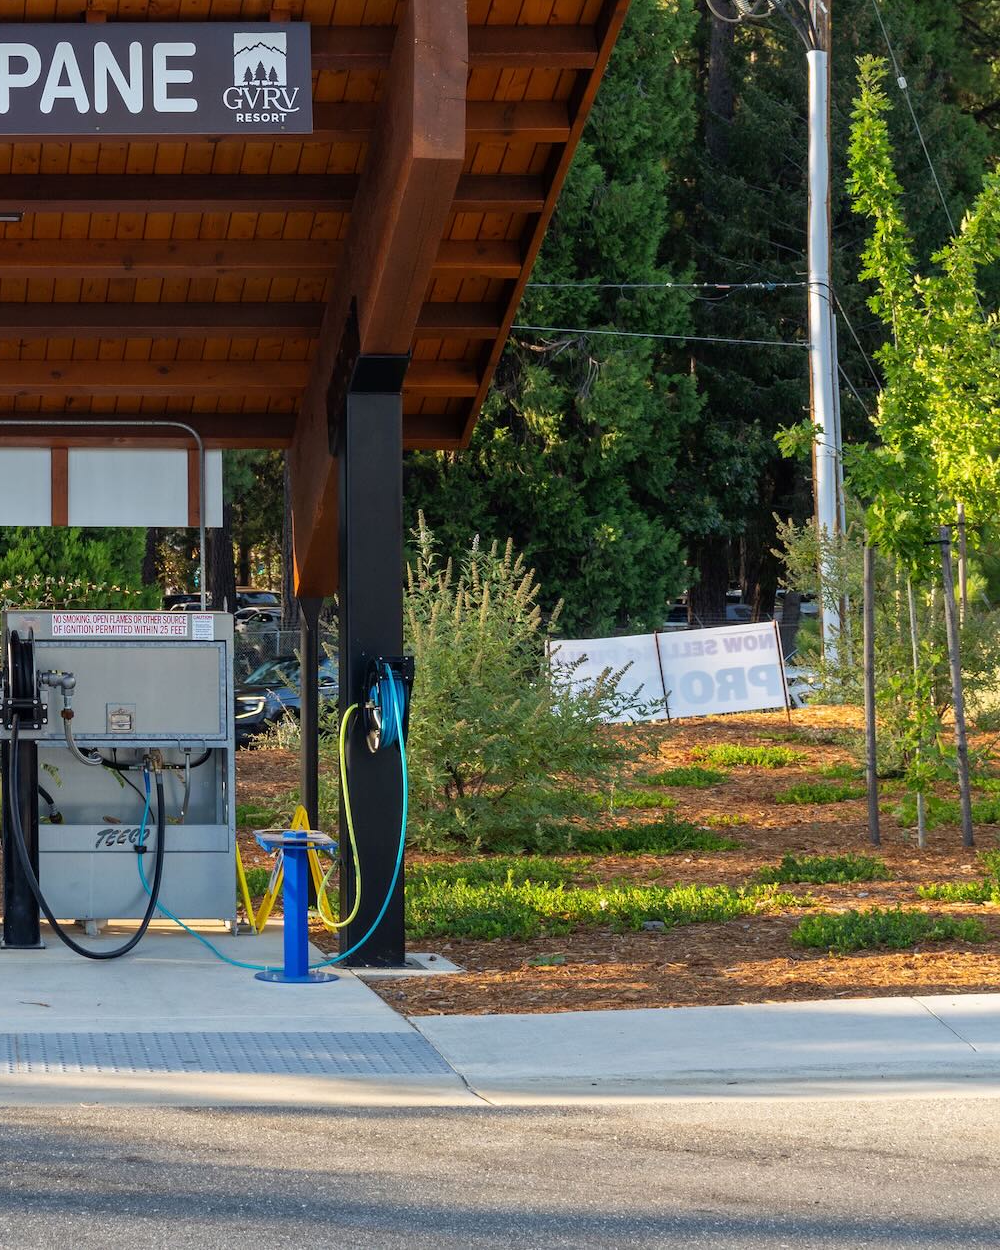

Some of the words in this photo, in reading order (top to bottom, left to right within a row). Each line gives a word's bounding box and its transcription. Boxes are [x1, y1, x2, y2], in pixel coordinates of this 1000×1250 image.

[222, 86, 300, 112] GVRV
[236, 113, 287, 122] RESORT
[53, 615, 63, 624] NO
[93, 615, 109, 624] OPEN
[110, 615, 133, 624] FLAMES
[134, 615, 142, 624] OR
[143, 615, 162, 624] OTHER
[163, 615, 187, 625] SOURCE
[53, 625, 63, 634] OF
[64, 625, 94, 635] IGNITION
[95, 625, 133, 635] PERMITTED
[134, 625, 159, 635] WITHIN
[160, 625, 169, 635] 25
[170, 625, 187, 635] FEET
